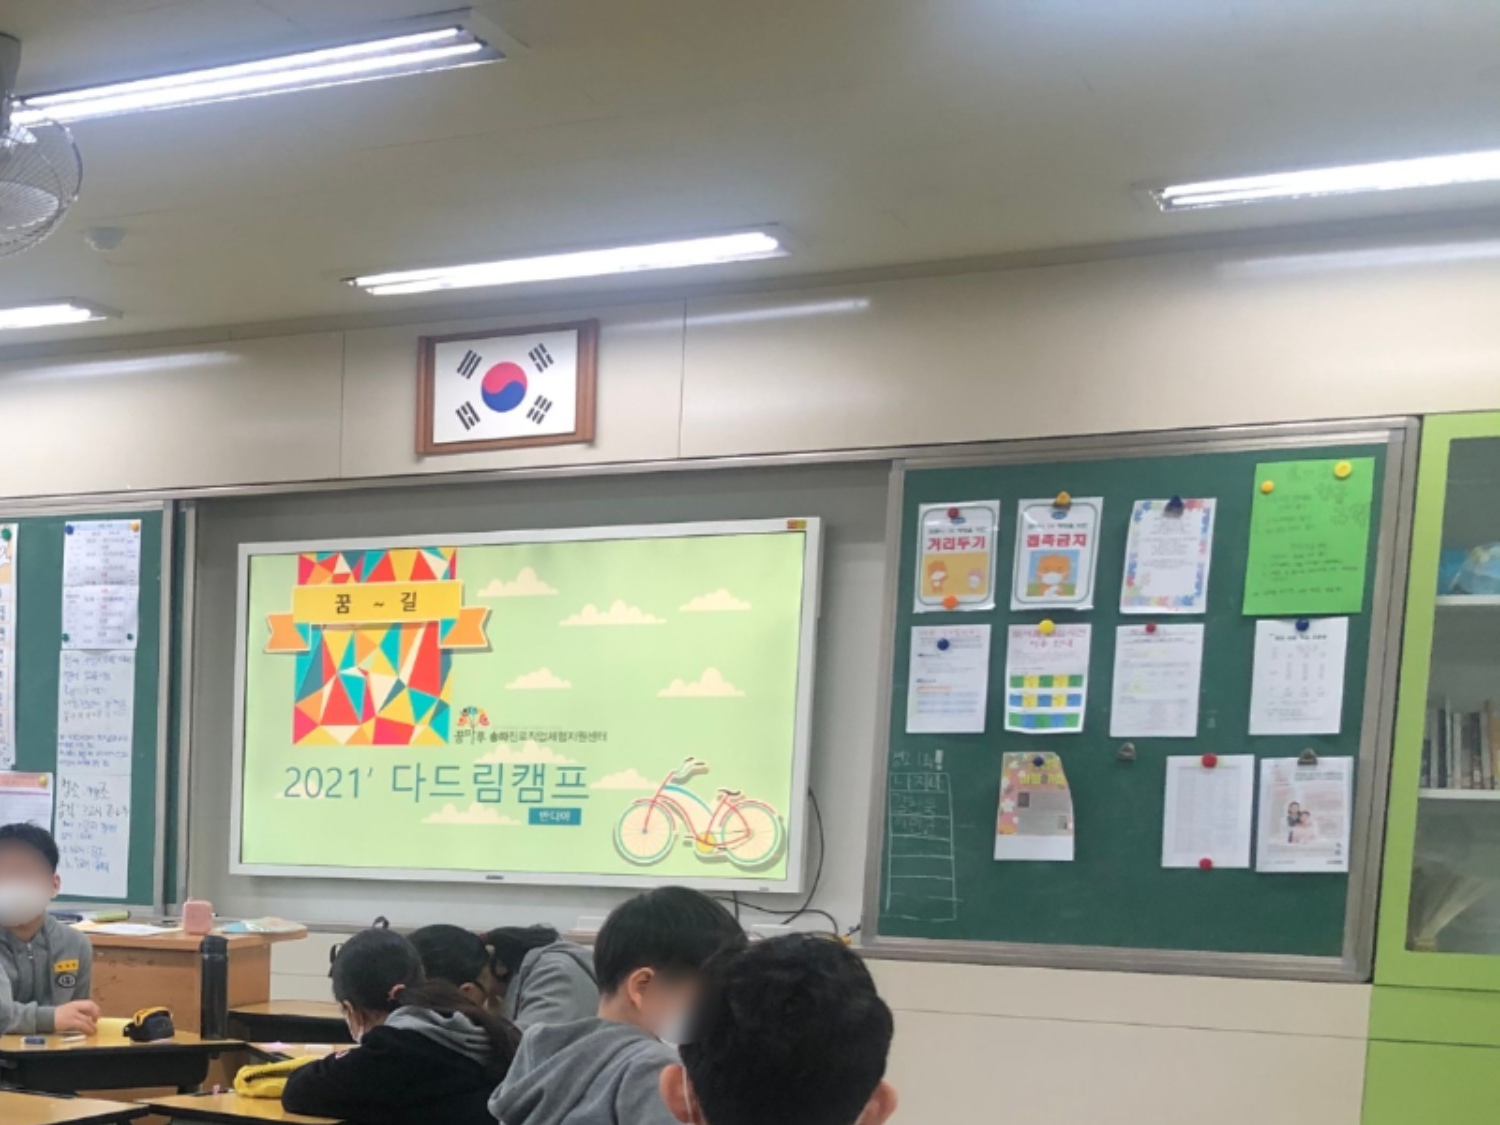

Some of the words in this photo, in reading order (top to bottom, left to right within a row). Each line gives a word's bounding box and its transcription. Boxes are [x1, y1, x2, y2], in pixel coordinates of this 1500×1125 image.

[927, 535, 986, 551] 거리두기
[334, 594, 351, 614] 꿈
[400, 591, 417, 612] 길
[391, 762, 590, 803] 다드림캠프
